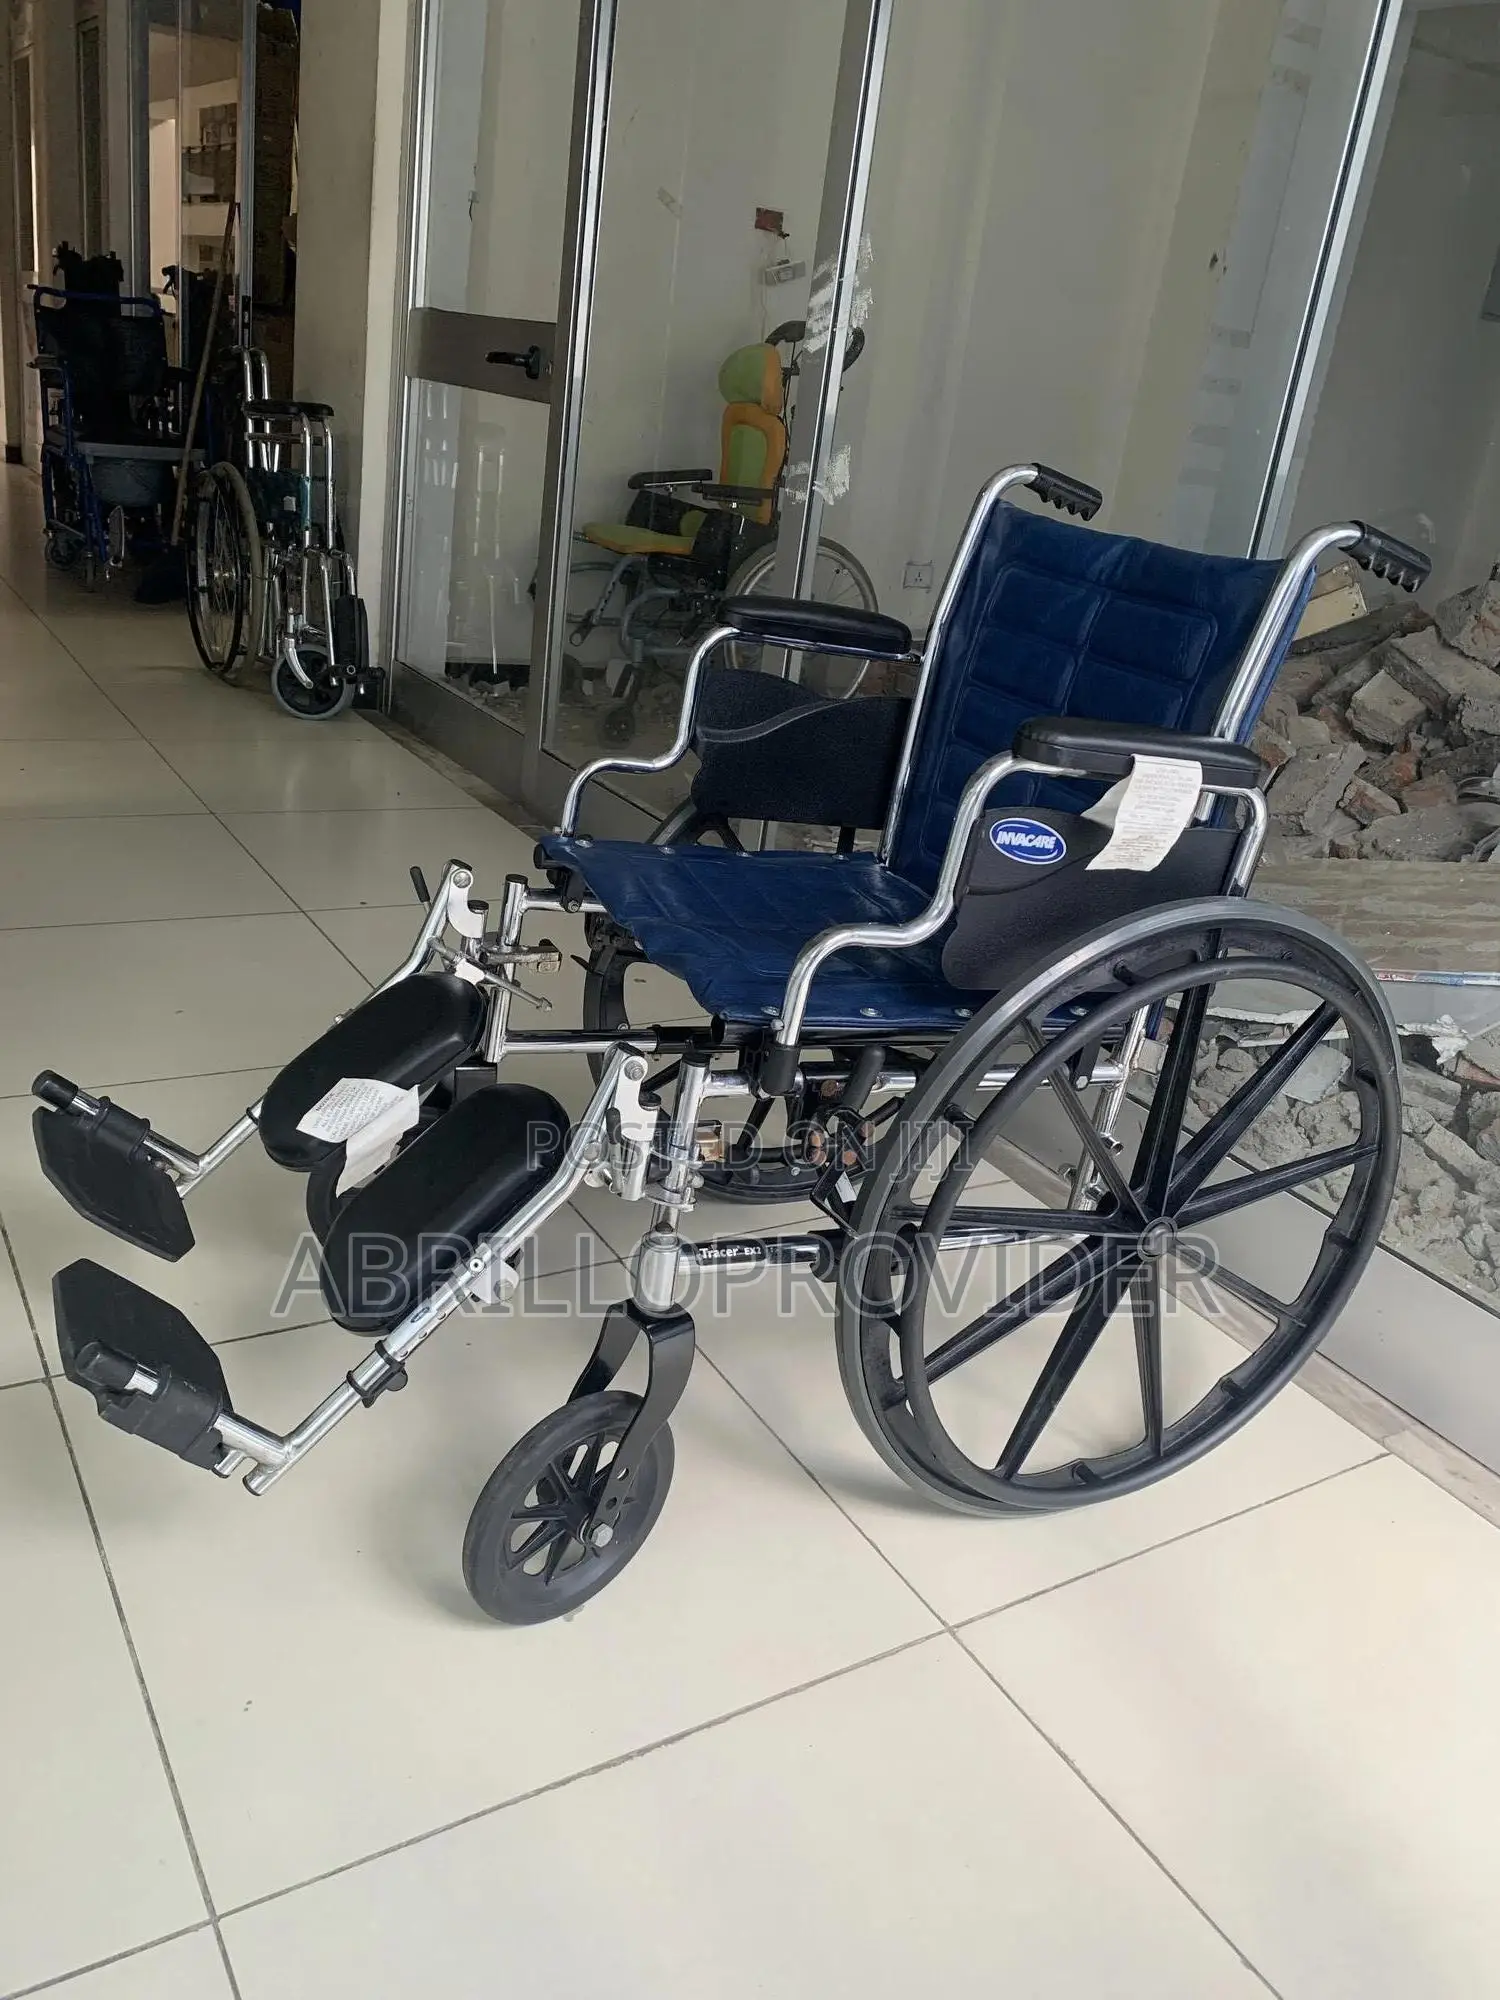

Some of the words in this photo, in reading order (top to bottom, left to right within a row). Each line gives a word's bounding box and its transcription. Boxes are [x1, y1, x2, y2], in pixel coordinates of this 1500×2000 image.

[996, 831, 1057, 849] INVACARE
[699, 1247, 738, 1259] Tracer
[744, 1246, 762, 1256] EX2
